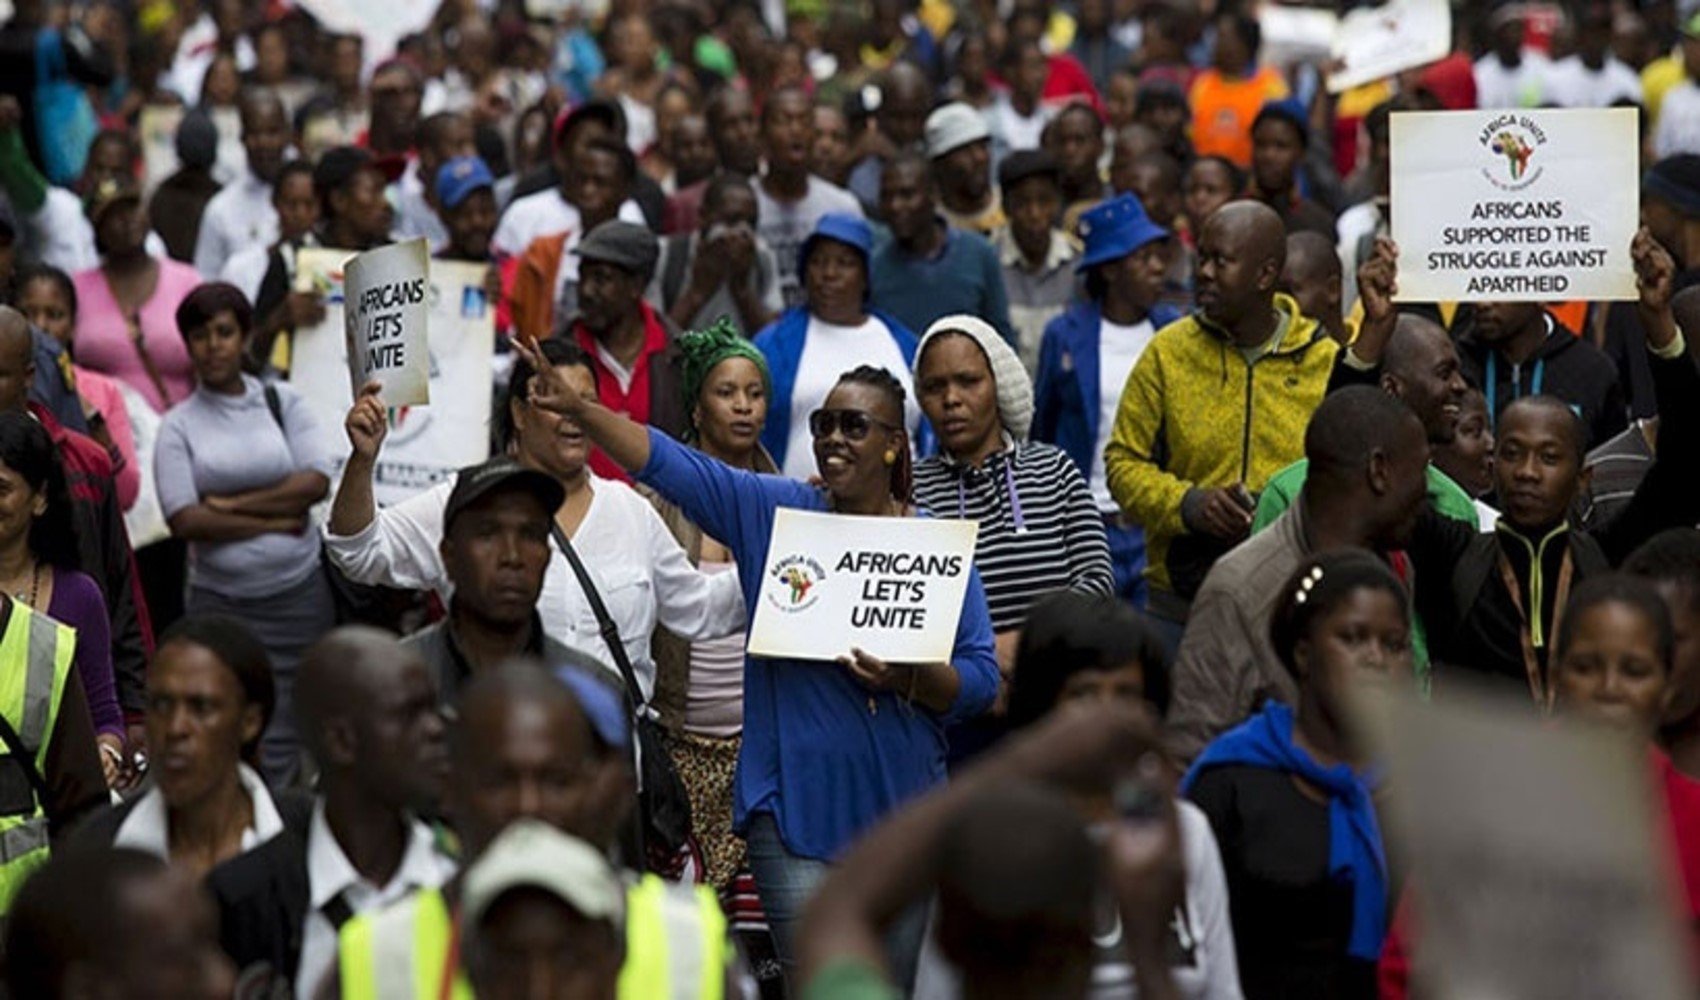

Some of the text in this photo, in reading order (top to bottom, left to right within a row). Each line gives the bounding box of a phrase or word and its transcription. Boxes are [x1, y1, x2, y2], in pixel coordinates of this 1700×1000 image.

[1480, 114, 1517, 146] AFRICA
[1471, 200, 1563, 219] AFRICANS
[1443, 225, 1590, 245] SUPPORTED THE
[1428, 248, 1607, 270] STRUGGLE AGAINST
[1467, 275, 1568, 294] APARTHEID
[359, 278, 424, 316] AFRICANS
[835, 551, 962, 577] AFRICANS
[861, 579, 926, 603] LET'S
[850, 606, 927, 629] UNITE
